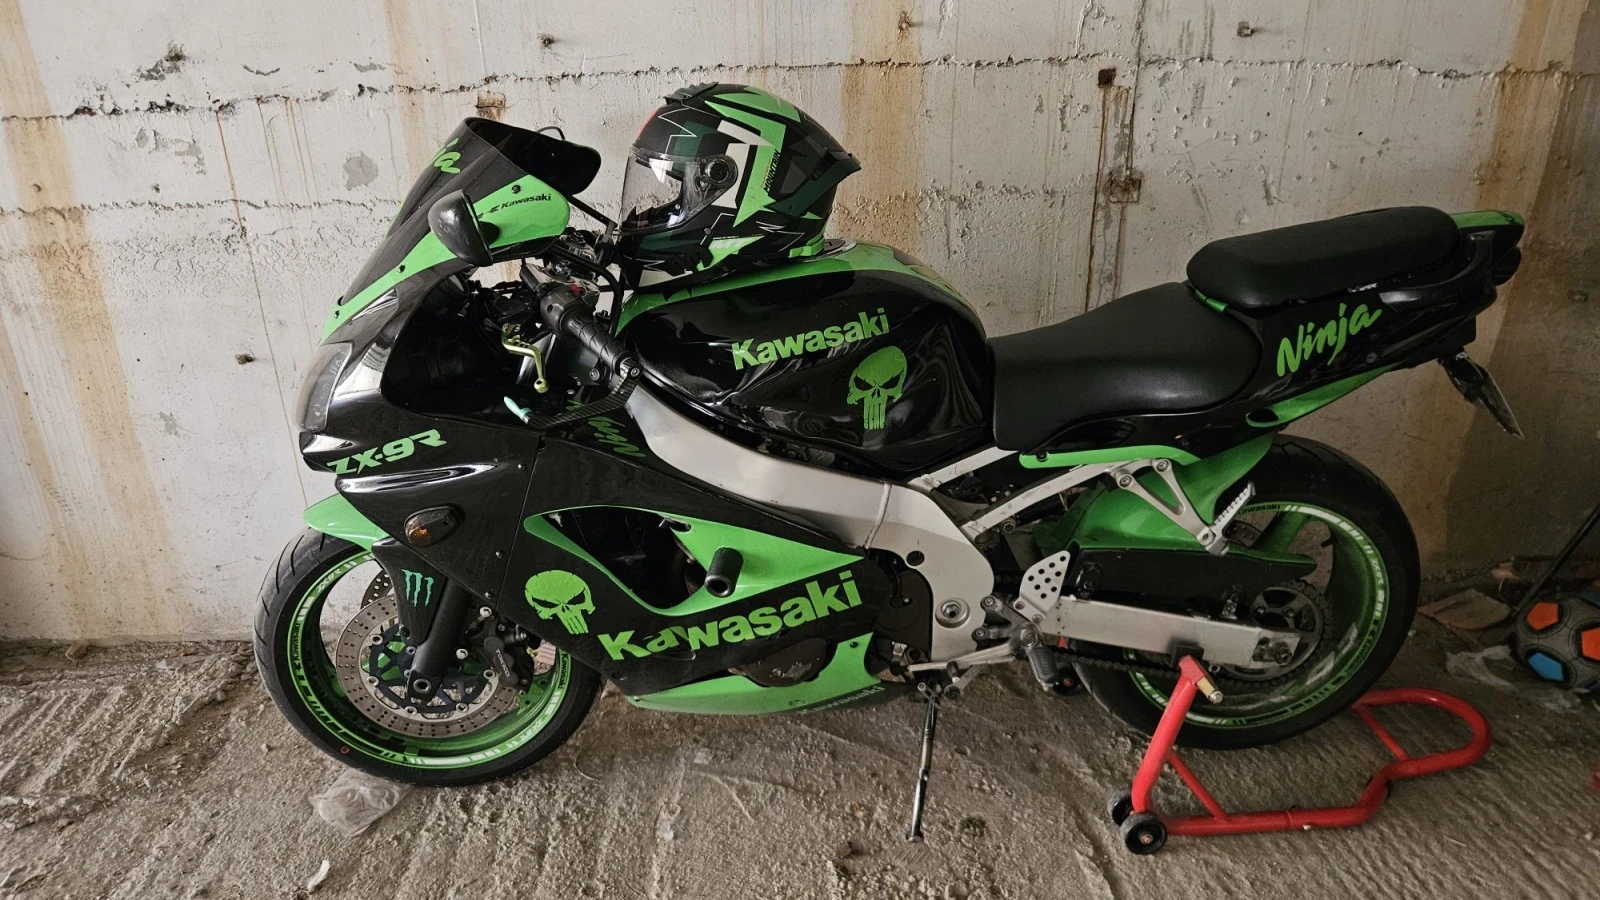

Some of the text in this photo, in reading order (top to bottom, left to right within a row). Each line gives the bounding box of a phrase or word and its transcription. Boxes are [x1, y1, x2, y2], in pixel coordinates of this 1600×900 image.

[501, 193, 551, 209] Kawasaki
[731, 307, 890, 370] Kawasaki
[1277, 302, 1382, 377] Ninja
[326, 428, 447, 475] ZX-9R
[597, 569, 863, 661] Kawasaki
[496, 648, 511, 678] TOKICO
